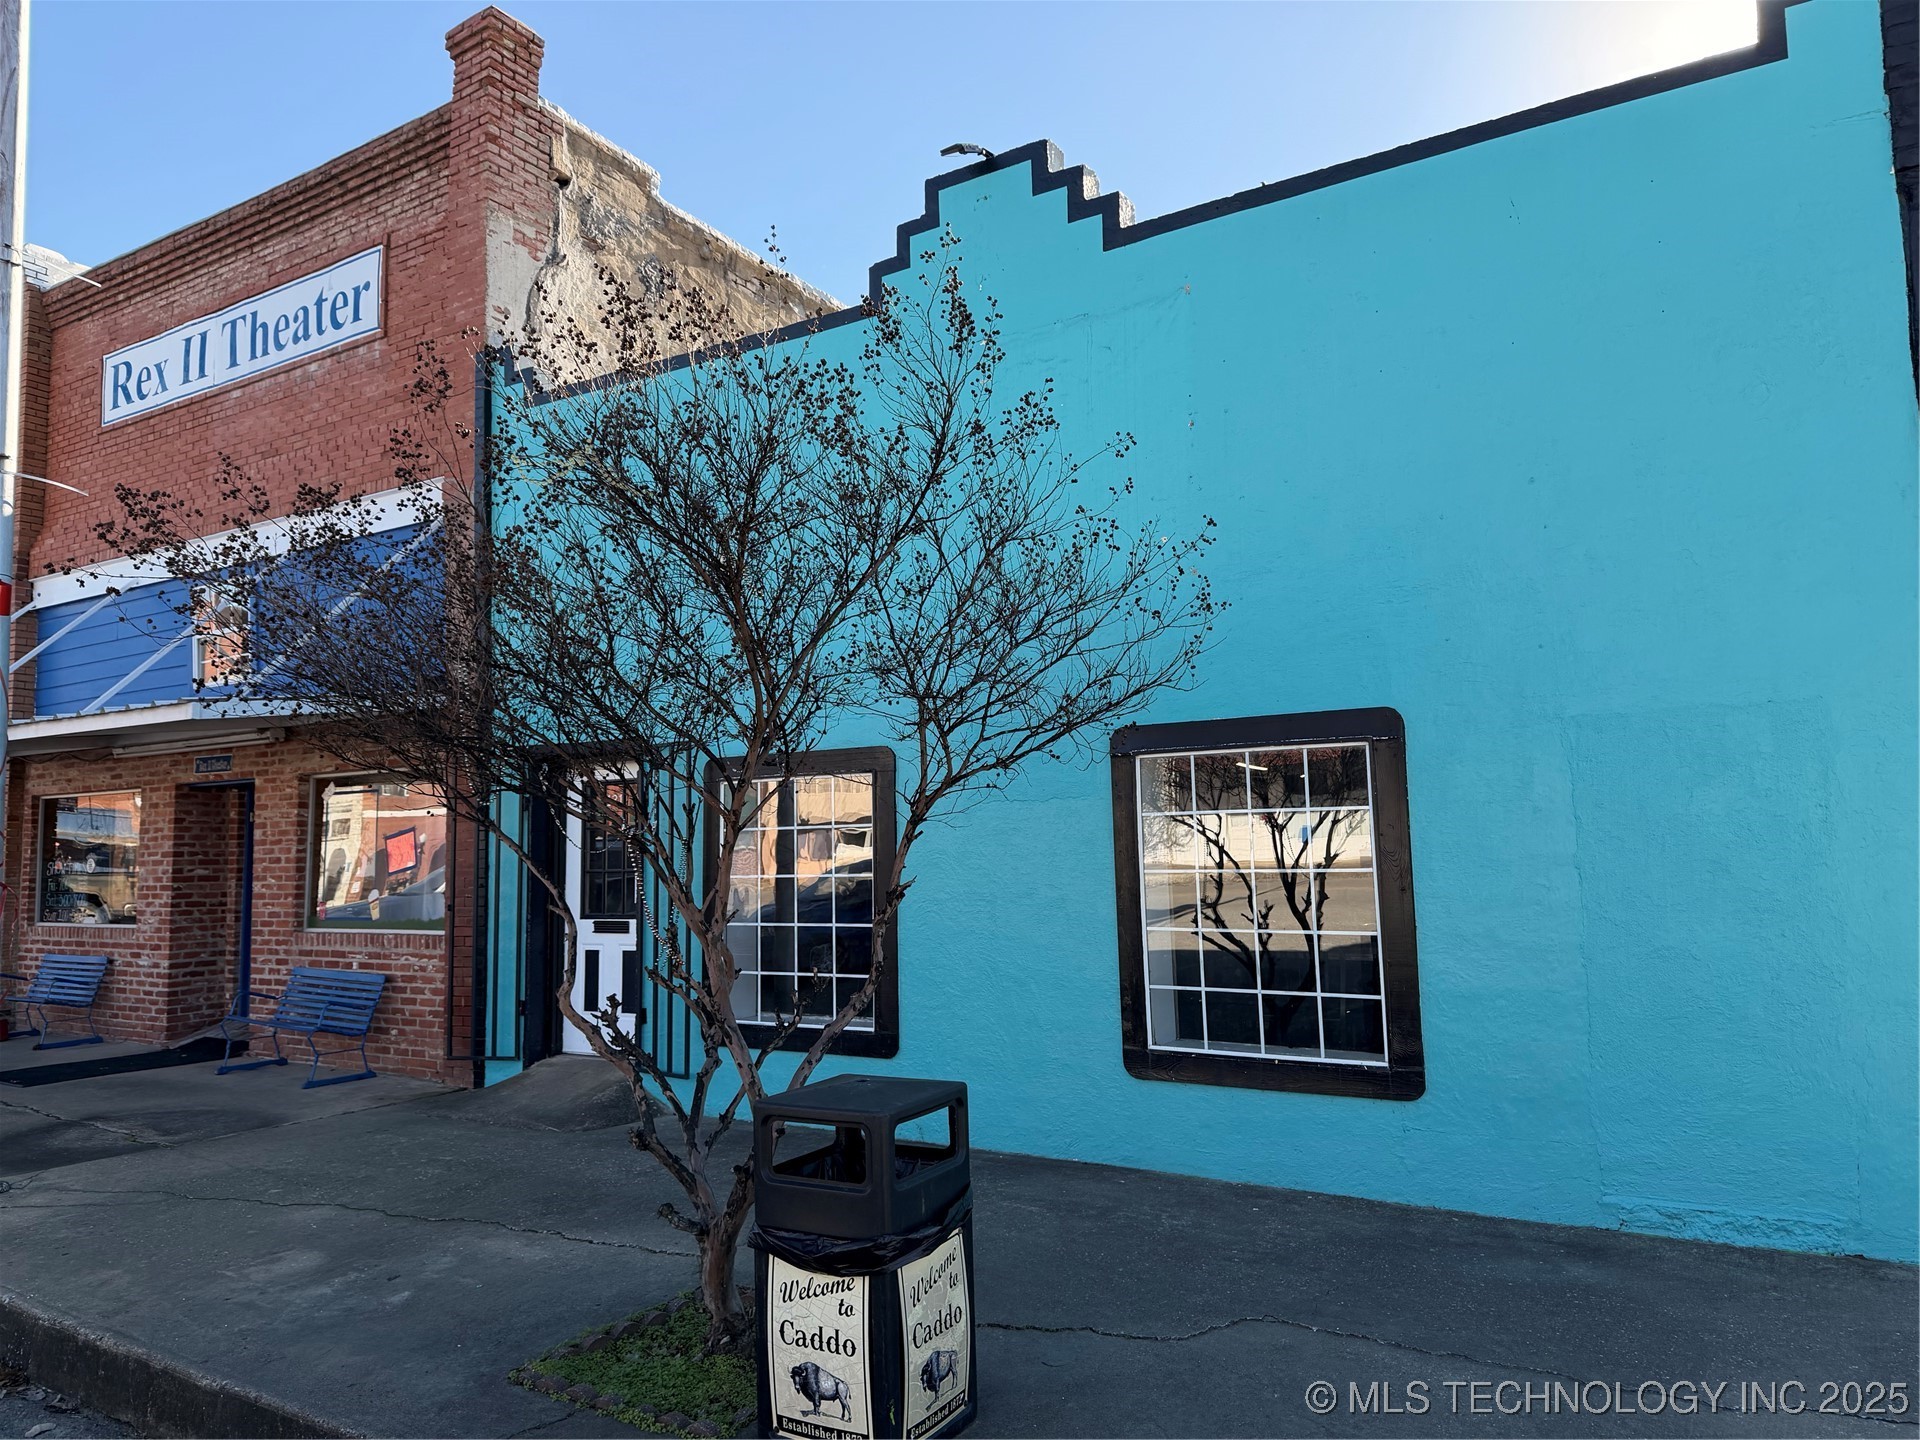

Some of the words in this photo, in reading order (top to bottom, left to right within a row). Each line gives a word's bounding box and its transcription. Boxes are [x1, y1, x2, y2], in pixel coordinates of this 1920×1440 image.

[111, 358, 169, 411] Rex
[179, 328, 212, 386] II
[221, 279, 371, 370] Theater
[779, 1277, 856, 1304] Welcome
[909, 1246, 958, 1308] Welcome
[949, 1272, 959, 1289] to
[838, 1298, 856, 1318] to
[779, 1319, 857, 1358] Caddo
[911, 1305, 963, 1350] Caddo
[782, 1417, 838, 1440] Established
[910, 1404, 949, 1439] Established
